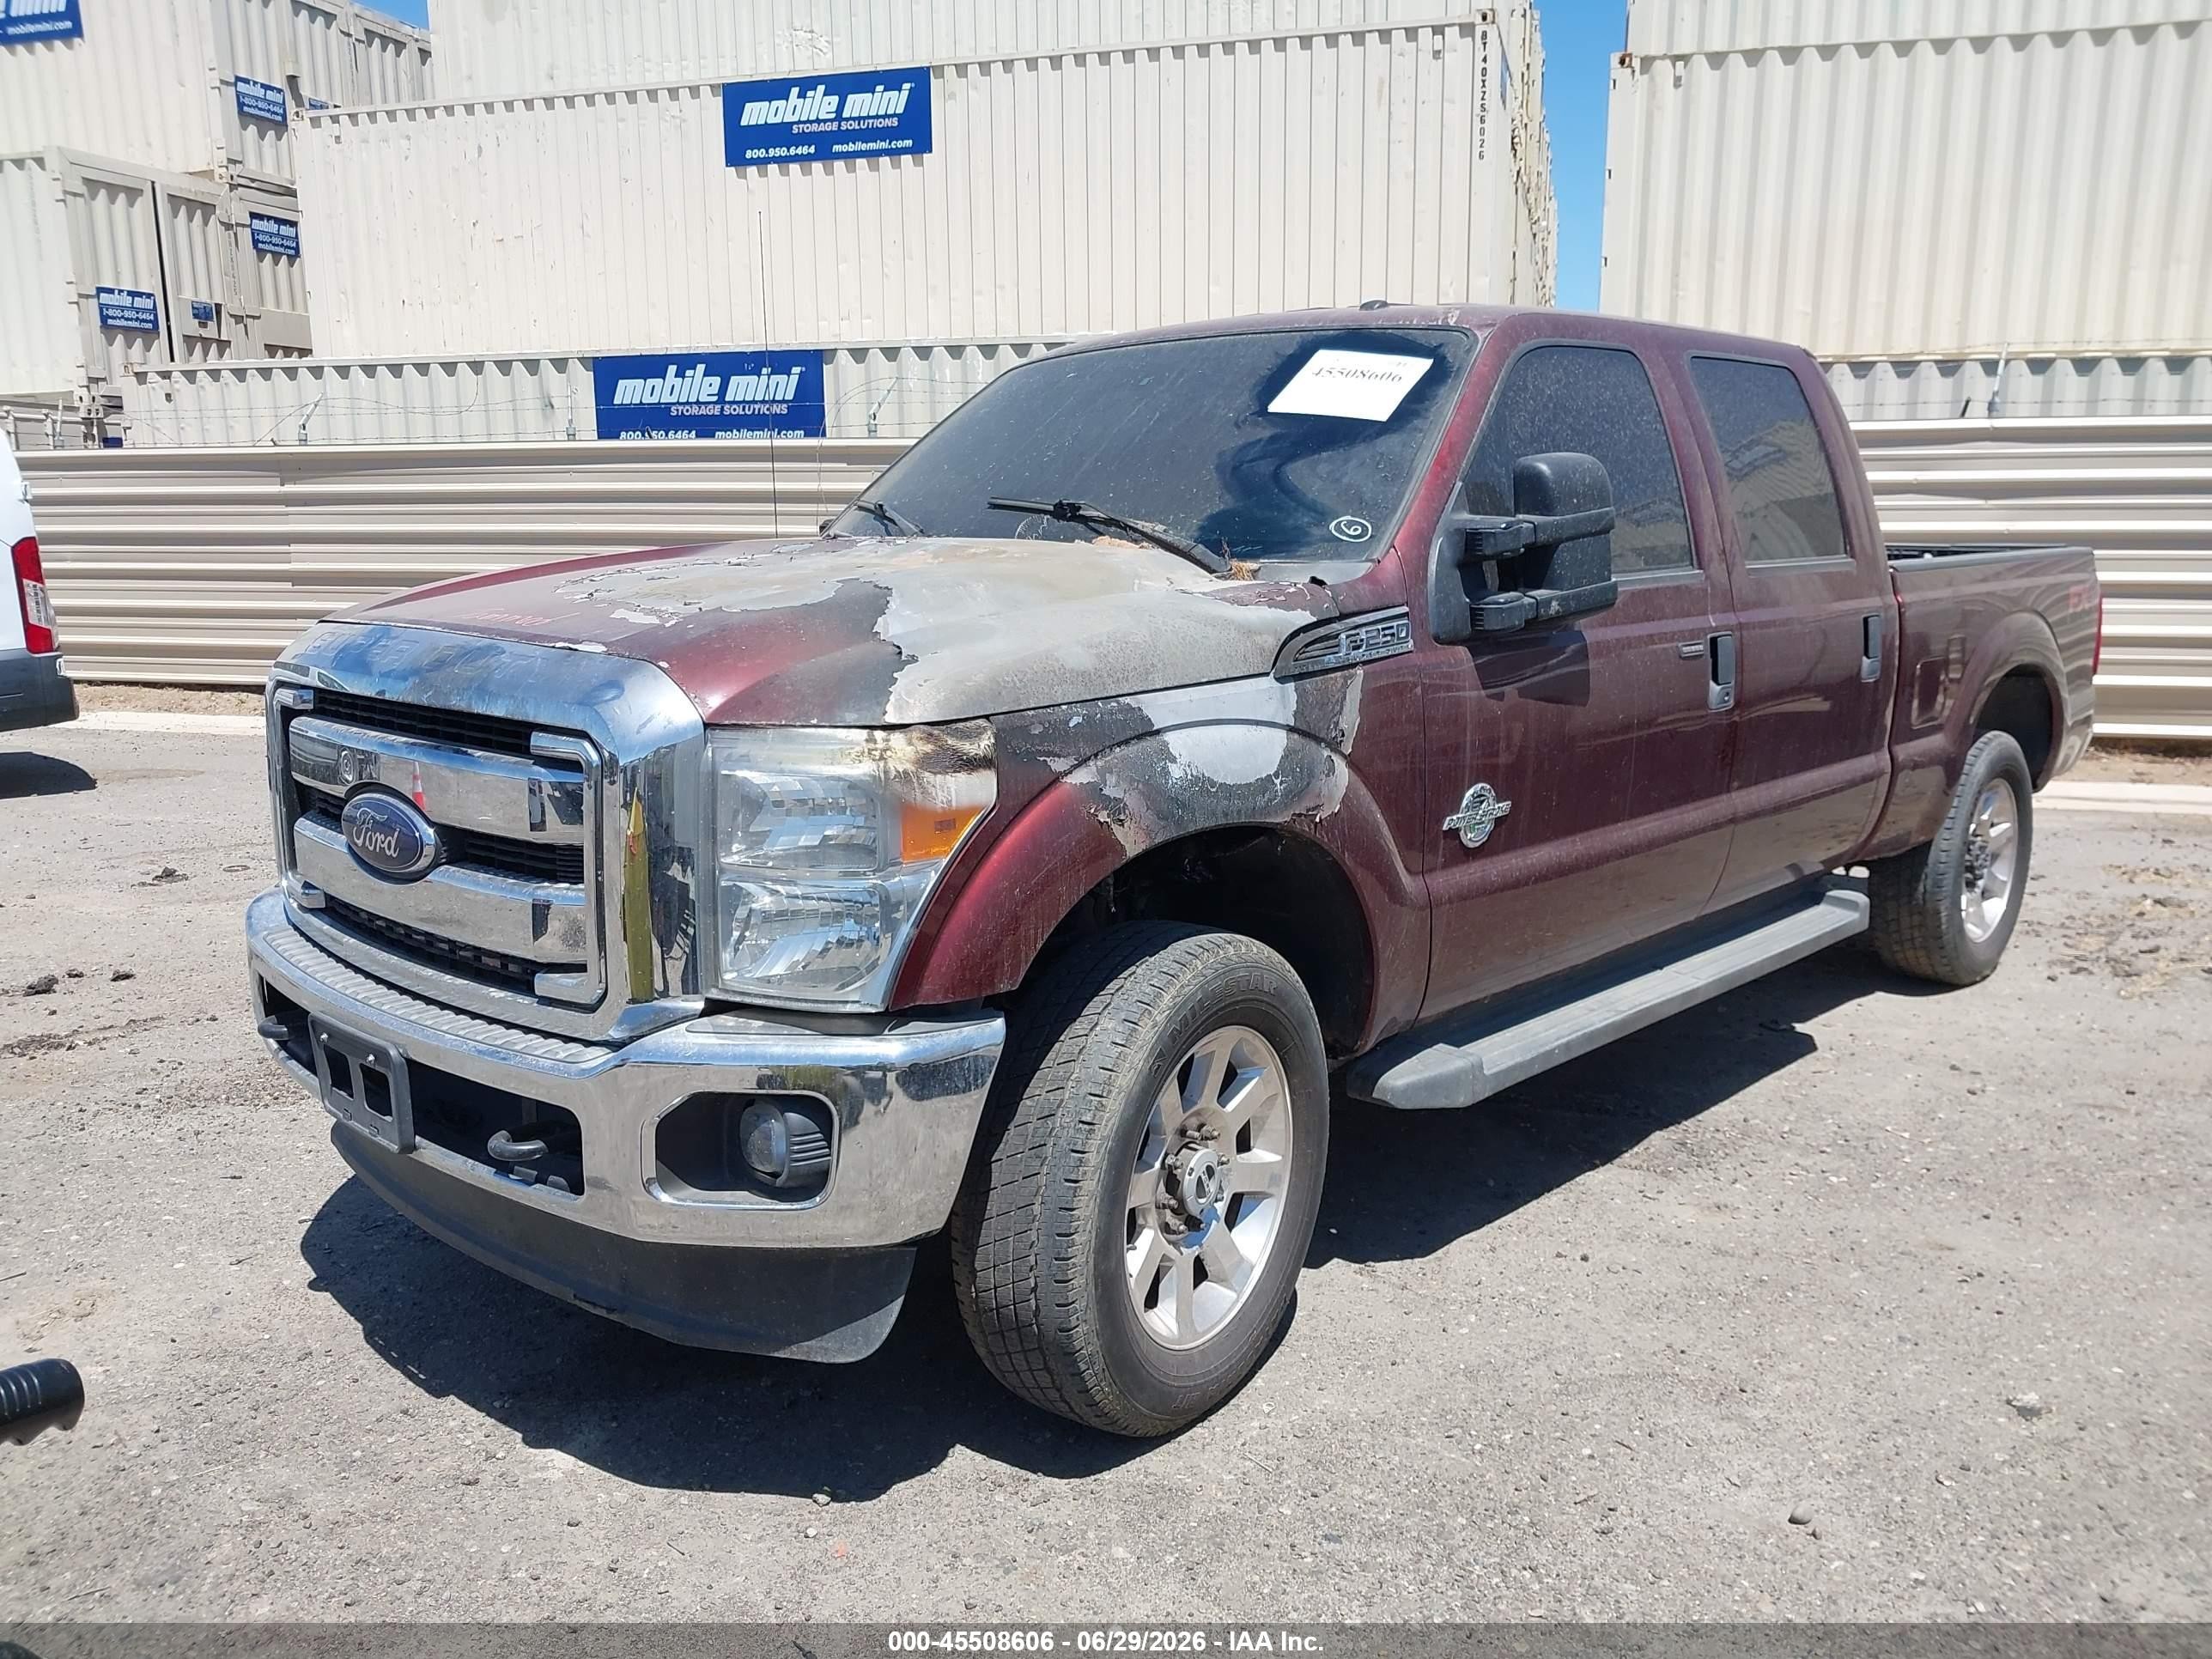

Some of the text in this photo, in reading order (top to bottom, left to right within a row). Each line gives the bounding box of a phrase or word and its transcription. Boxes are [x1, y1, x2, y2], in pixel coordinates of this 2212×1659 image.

[6, 20, 72, 35] mobilemini.com
[236, 80, 284, 104] mobile mini
[740, 82, 911, 126] mobile mini
[242, 106, 283, 122] mobilemini.com
[792, 117, 899, 134] STORAGE SOLUTIONS
[744, 137, 914, 160] 800.950.6464 mobilemini.com
[251, 216, 297, 238] mobile mini
[258, 242, 296, 256] mobilemini.com
[99, 289, 155, 310] mobile mini
[106, 318, 154, 330] mobilemini.com
[1311, 366, 1403, 383] 45508606
[612, 364, 802, 405] mobile mini
[670, 403, 788, 416] STORAGE SOLUTIONS
[714, 427, 805, 440] mobilemini.com
[353, 807, 400, 858] Ford
